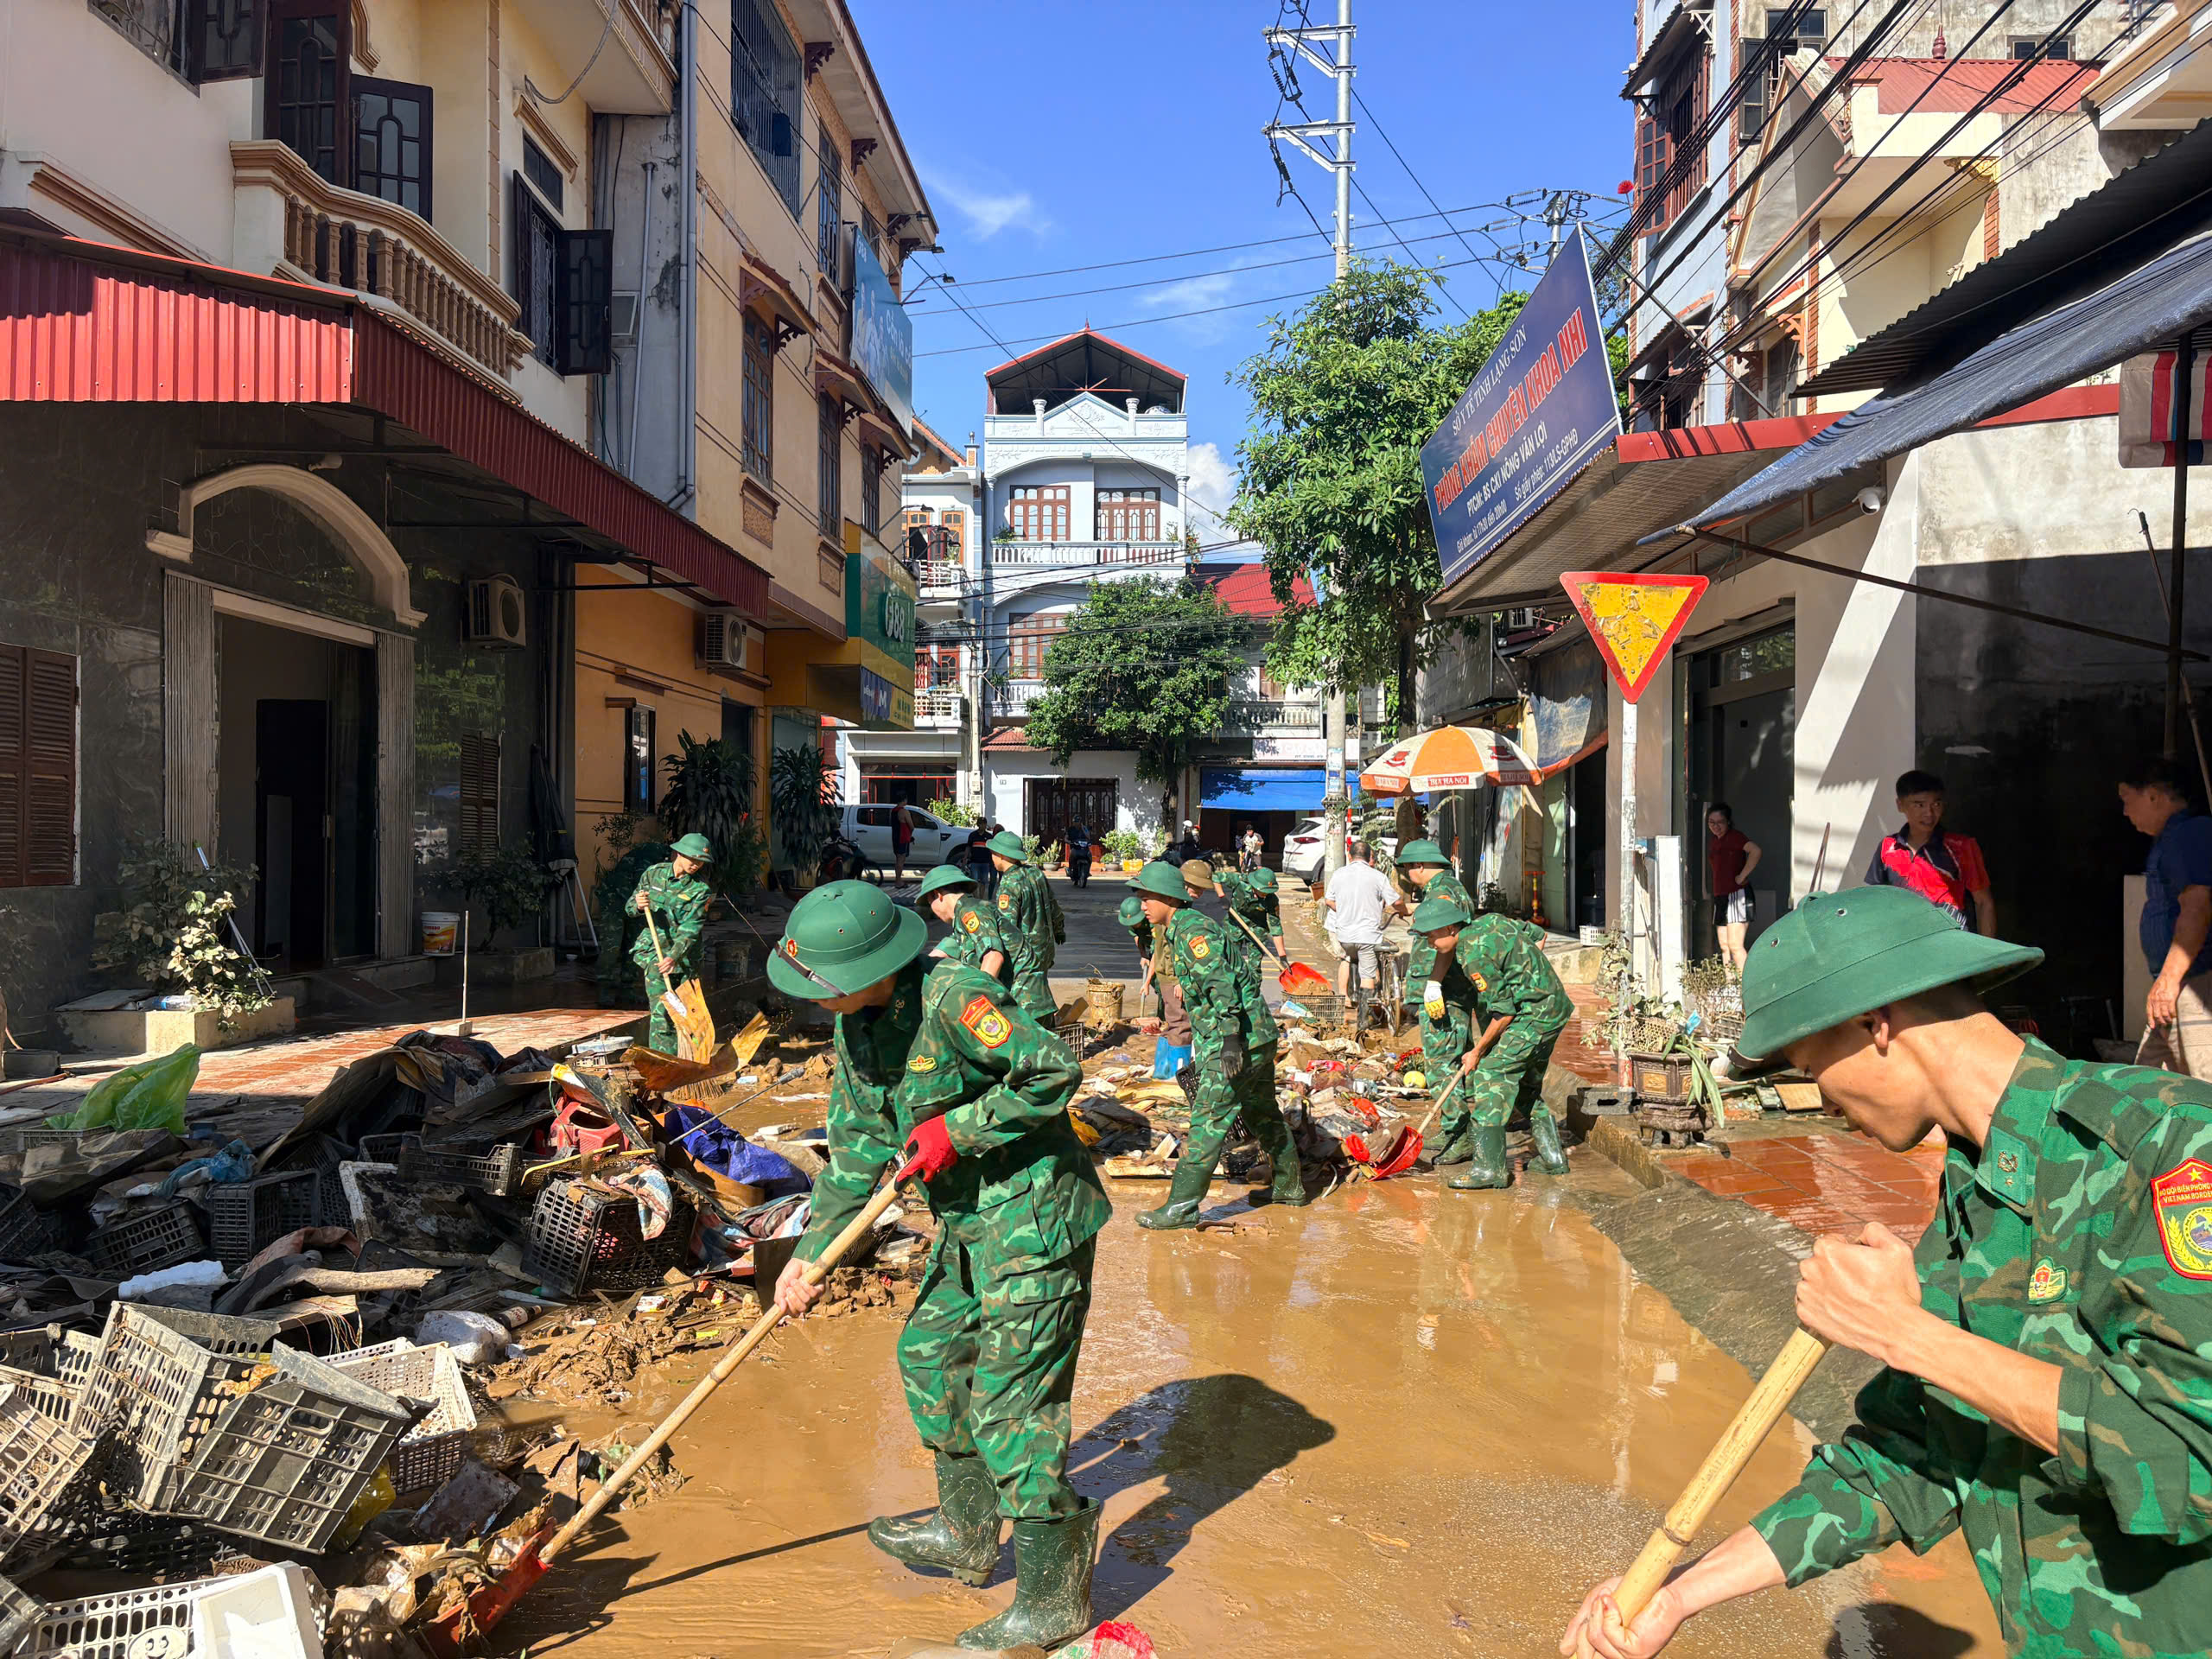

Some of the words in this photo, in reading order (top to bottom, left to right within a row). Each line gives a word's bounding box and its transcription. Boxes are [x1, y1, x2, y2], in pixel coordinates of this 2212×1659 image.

[1460, 410, 1466, 425] Y
[1465, 390, 1476, 418] TẾ
[1491, 349, 1510, 386] LẠNG
[1510, 324, 1527, 359] SƠN
[1485, 382, 1528, 458] CHUYÊN
[1524, 341, 1562, 414] KHOA
[1557, 306, 1588, 374] NHI
[1482, 481, 1491, 502] BS
[1500, 452, 1521, 486] NÔNG
[1519, 434, 1535, 463] VĂN
[1534, 419, 1548, 449] LỢI
[2177, 1183, 2190, 1193] BIÊN
[2177, 1192, 2191, 1202] NAM
[2190, 1191, 2212, 1200] BORDE
